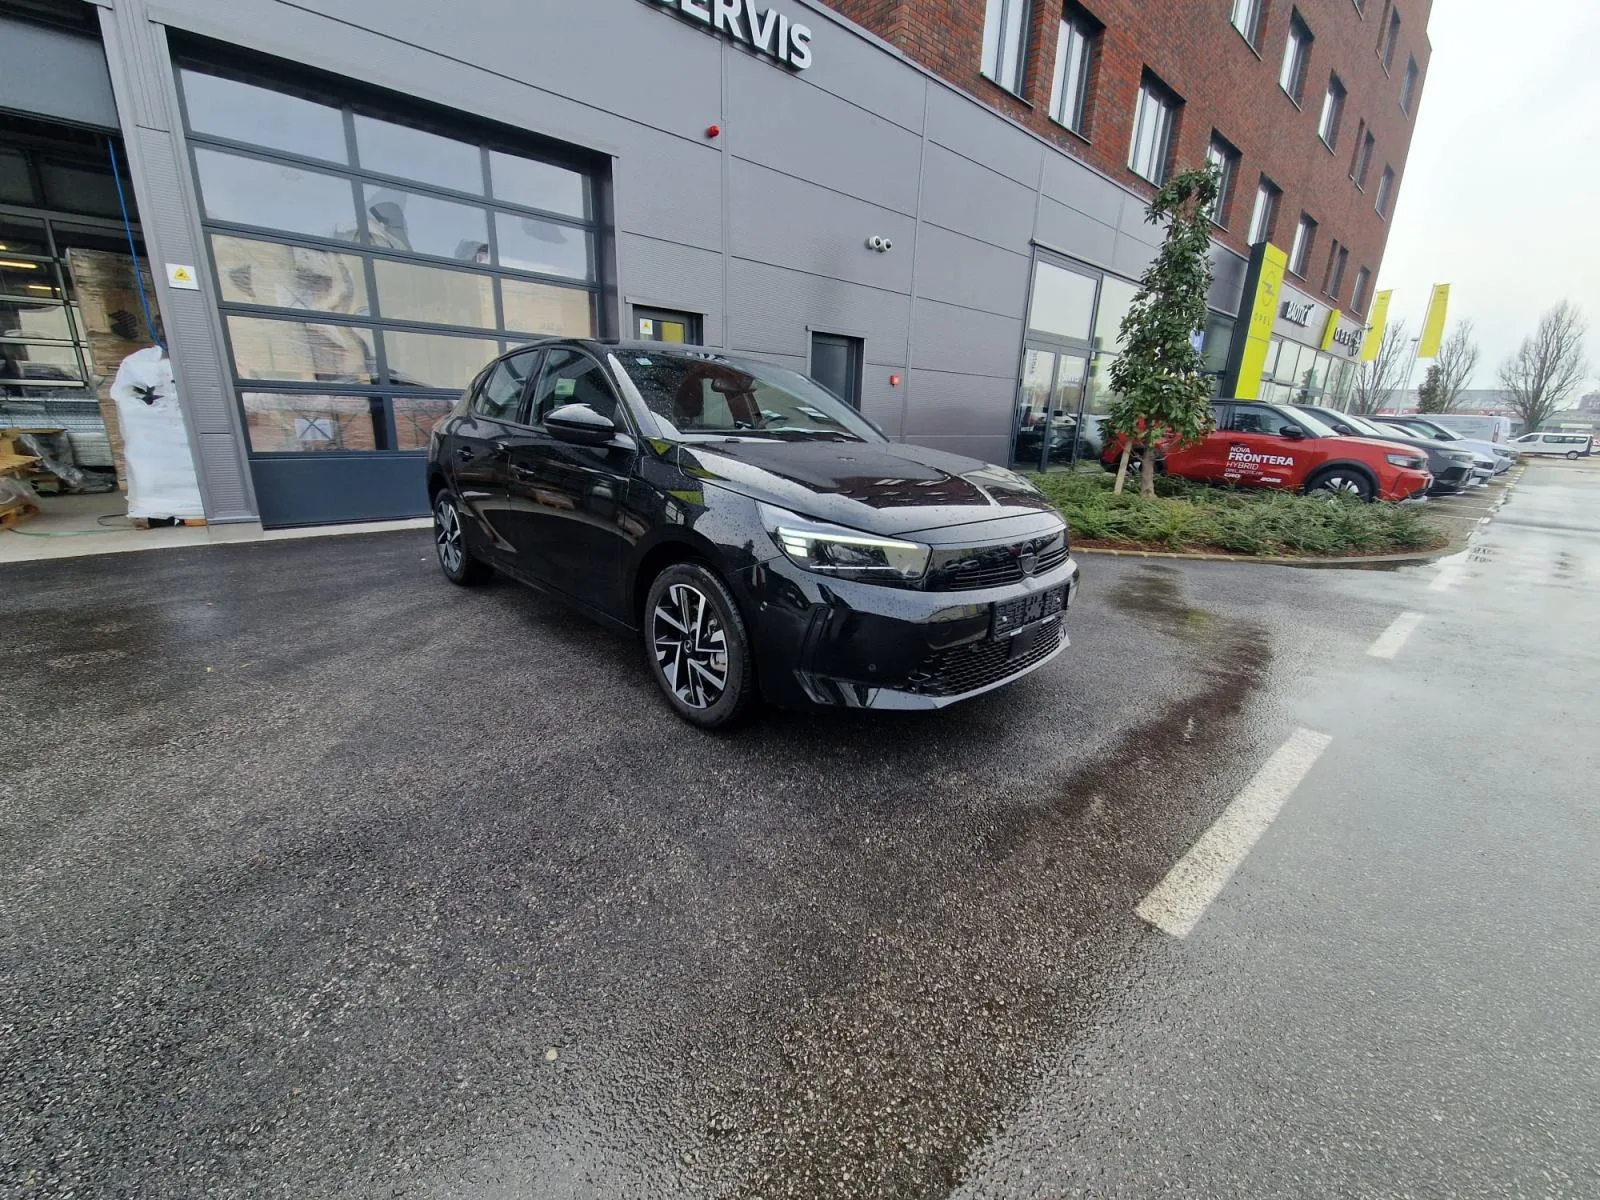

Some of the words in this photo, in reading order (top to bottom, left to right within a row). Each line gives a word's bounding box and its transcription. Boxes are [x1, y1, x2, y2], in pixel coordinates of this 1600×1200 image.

[660, 0, 812, 69] RVIS
[1226, 461, 1259, 470] HYBRID
[1228, 452, 1294, 466] FRONTERA
